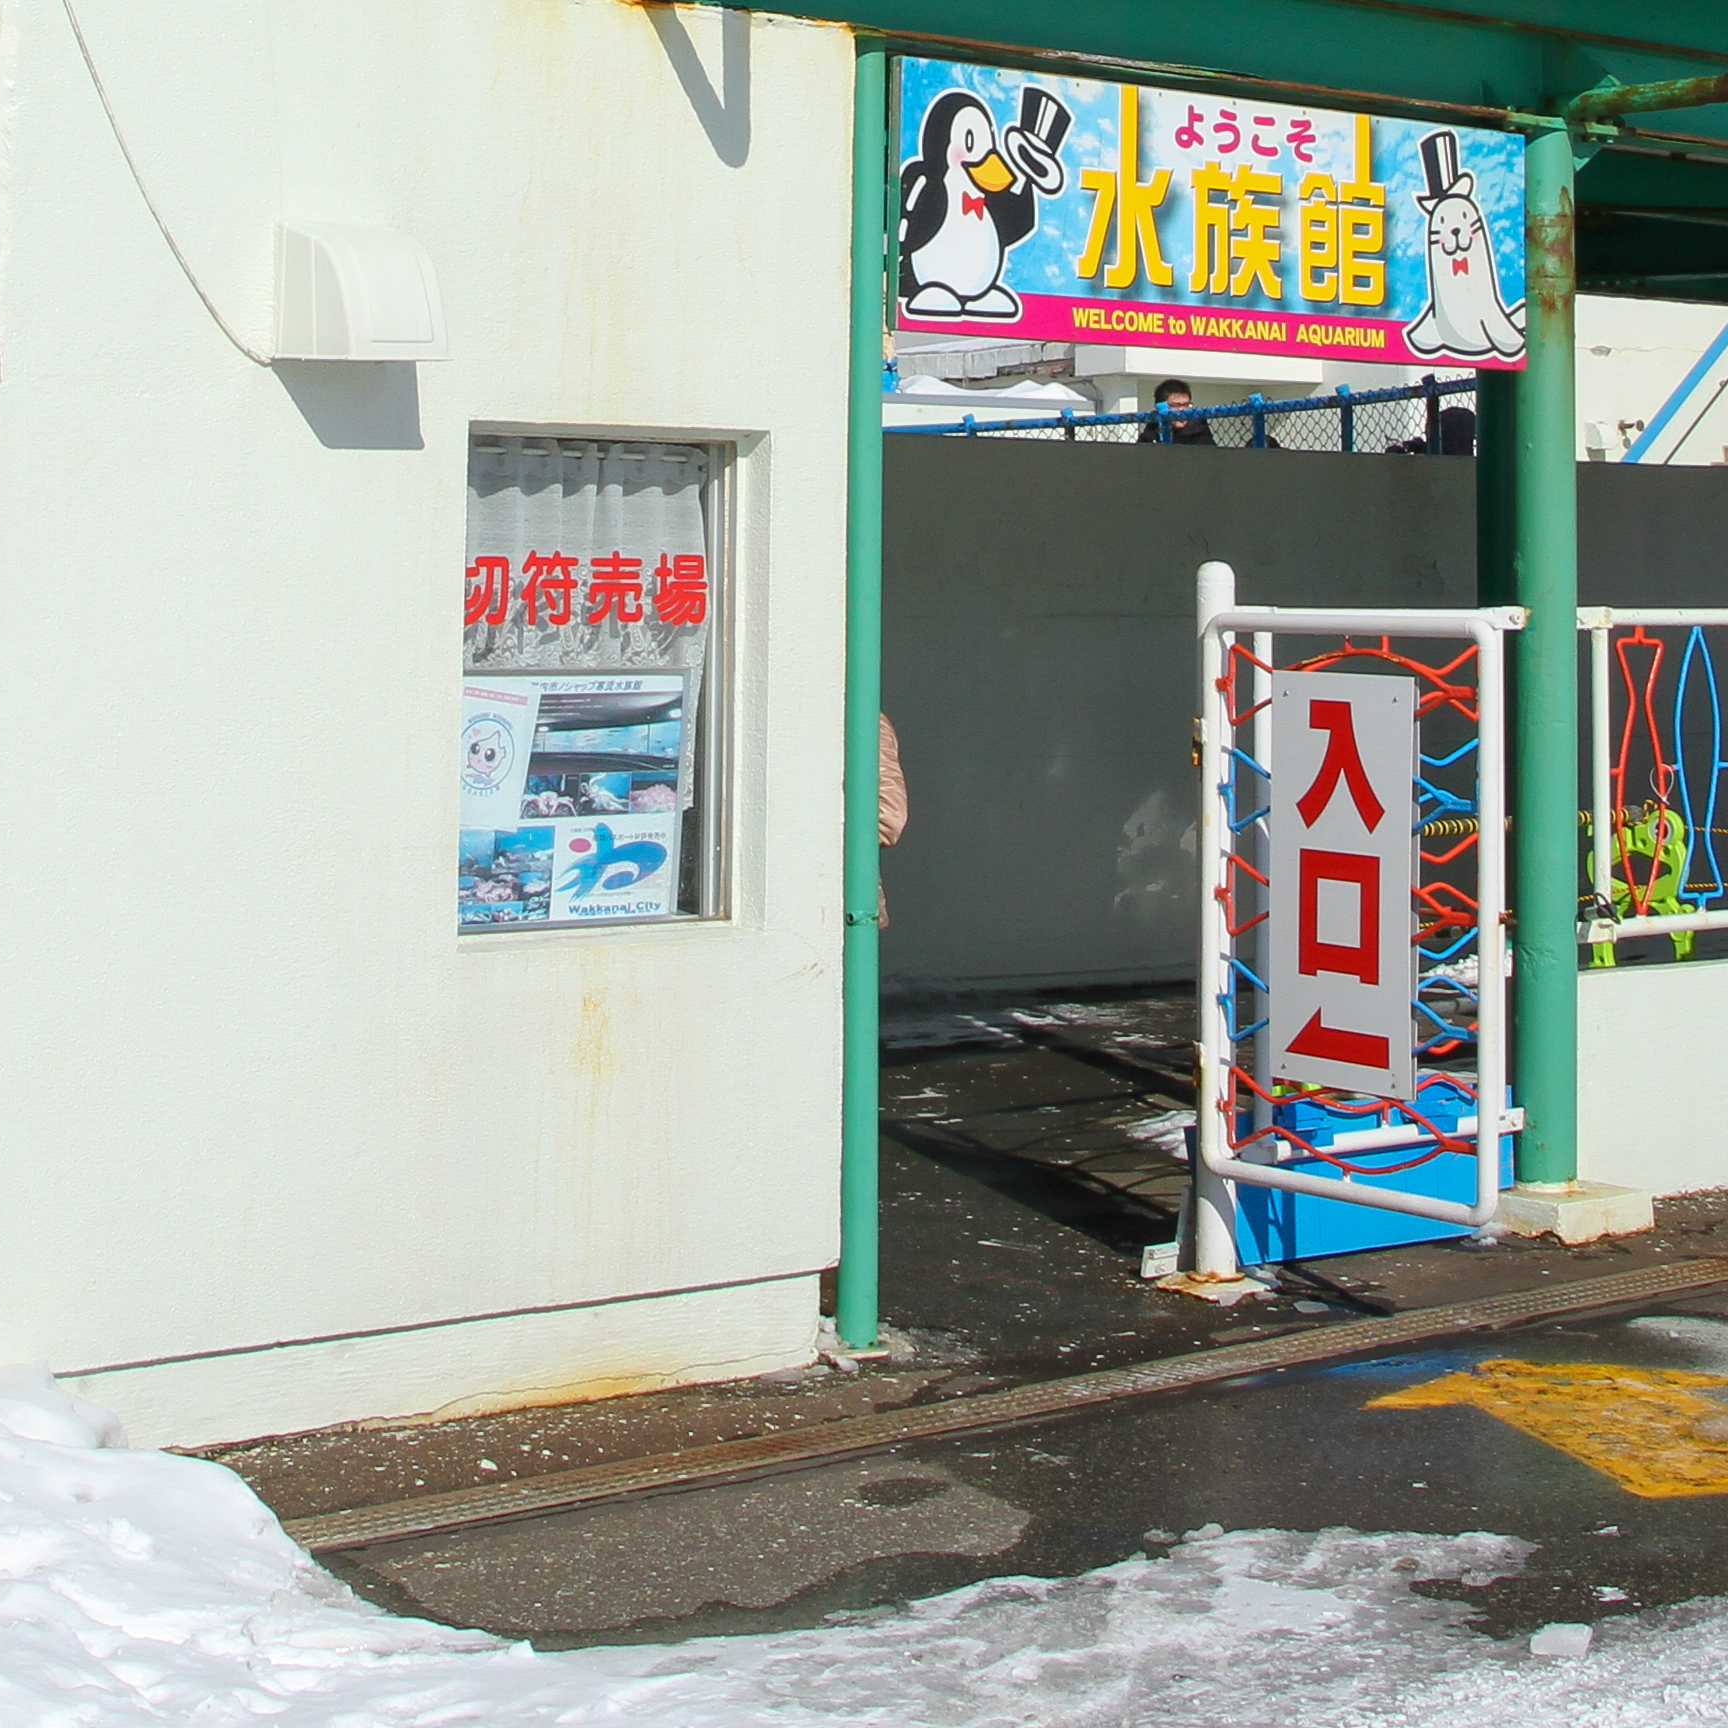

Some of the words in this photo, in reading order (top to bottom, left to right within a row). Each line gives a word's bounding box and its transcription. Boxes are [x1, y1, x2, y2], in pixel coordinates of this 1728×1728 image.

[1174, 105, 1318, 163] ようこそ
[1079, 85, 1386, 307] 水族館
[1072, 307, 1165, 333] WELCOME
[1168, 316, 1186, 335] to
[1190, 314, 1287, 342] WAKKANAI
[1296, 323, 1386, 348] AQUARIUM
[464, 549, 708, 626] 切符売場
[1296, 699, 1385, 986] 入口
